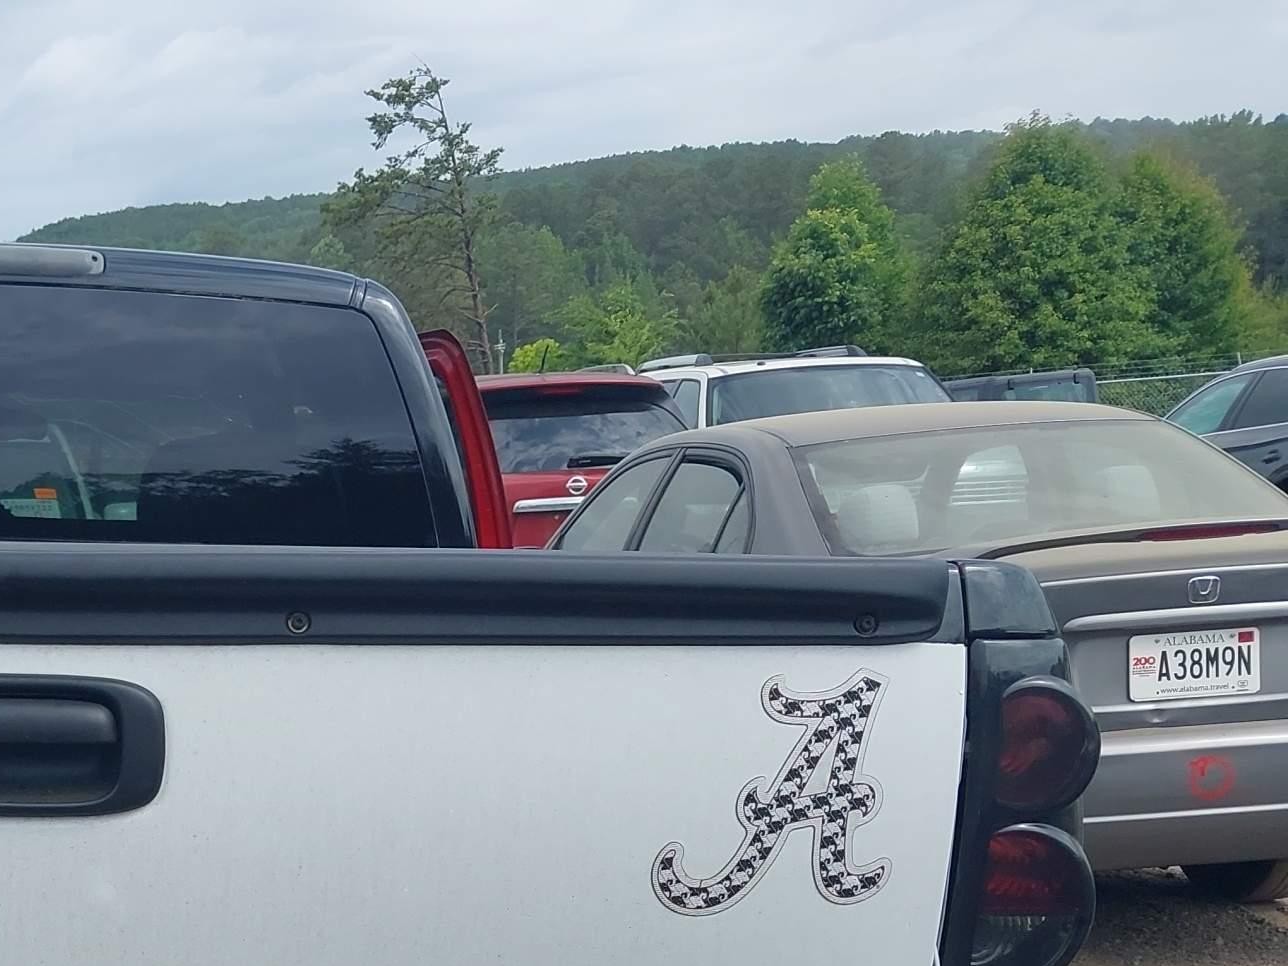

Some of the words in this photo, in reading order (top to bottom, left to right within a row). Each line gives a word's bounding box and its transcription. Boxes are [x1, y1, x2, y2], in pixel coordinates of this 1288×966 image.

[1163, 633, 1226, 646] ALABAMA
[1133, 656, 1156, 667] 200
[1157, 645, 1252, 682] A38M9N
[1160, 683, 1230, 694] www.alabama.travel
